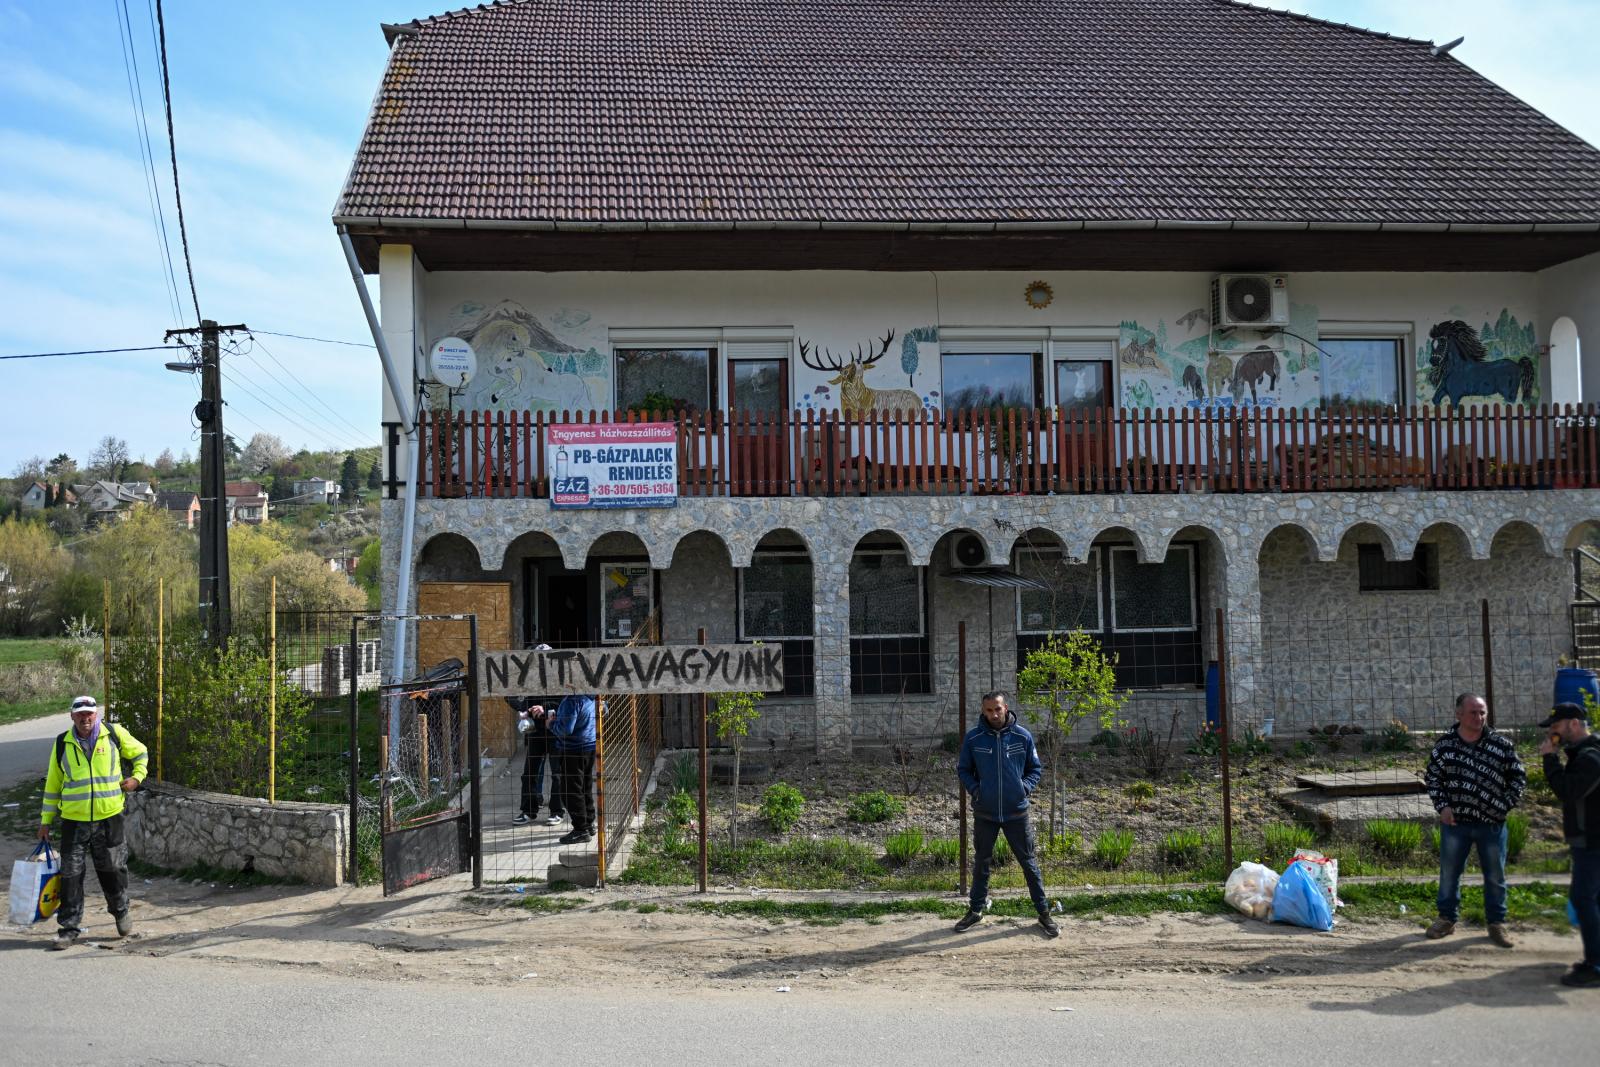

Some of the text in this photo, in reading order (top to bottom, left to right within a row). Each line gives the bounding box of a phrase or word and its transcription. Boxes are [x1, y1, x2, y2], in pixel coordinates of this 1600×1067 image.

[553, 427, 672, 441] Ingyenes házhozszállítás
[573, 446, 673, 464] PB-GÁZPALACK
[608, 463, 673, 481] RENDELÉS
[556, 478, 586, 493] GÁZ
[592, 482, 674, 496] +36-30/505-1364
